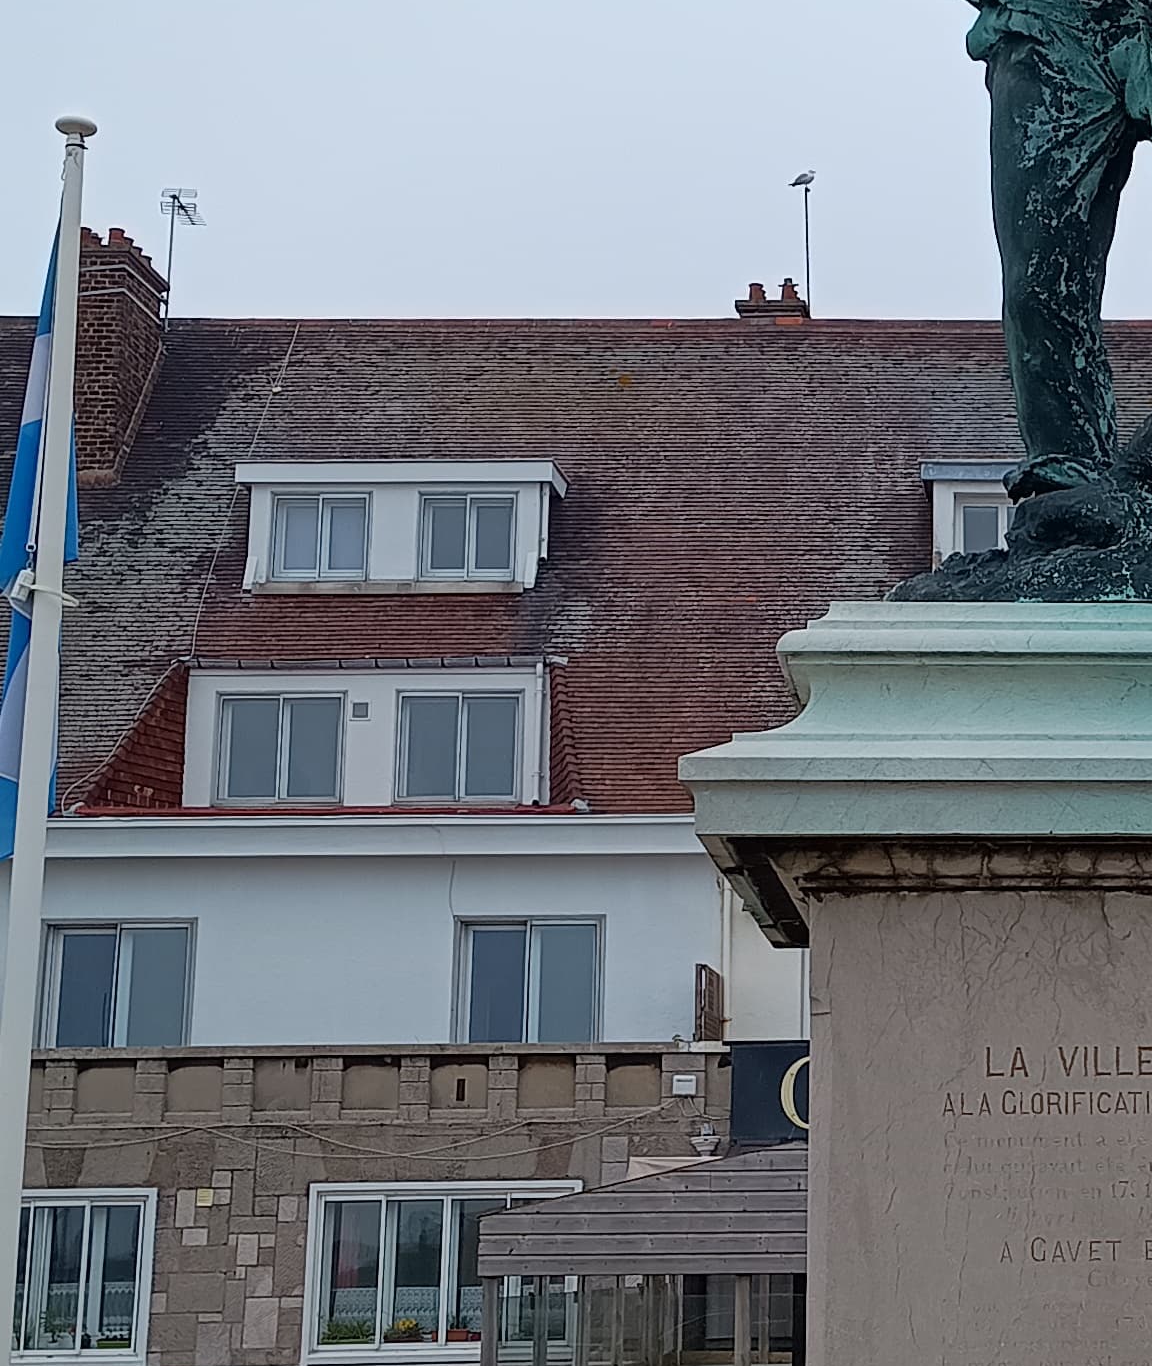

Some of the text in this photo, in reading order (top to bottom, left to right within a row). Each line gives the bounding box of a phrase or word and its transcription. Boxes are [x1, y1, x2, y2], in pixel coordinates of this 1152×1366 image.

[985, 1046, 1029, 1078] LA
[1000, 1240, 1013, 1264] A
[1031, 1236, 1122, 1263] GAVET
